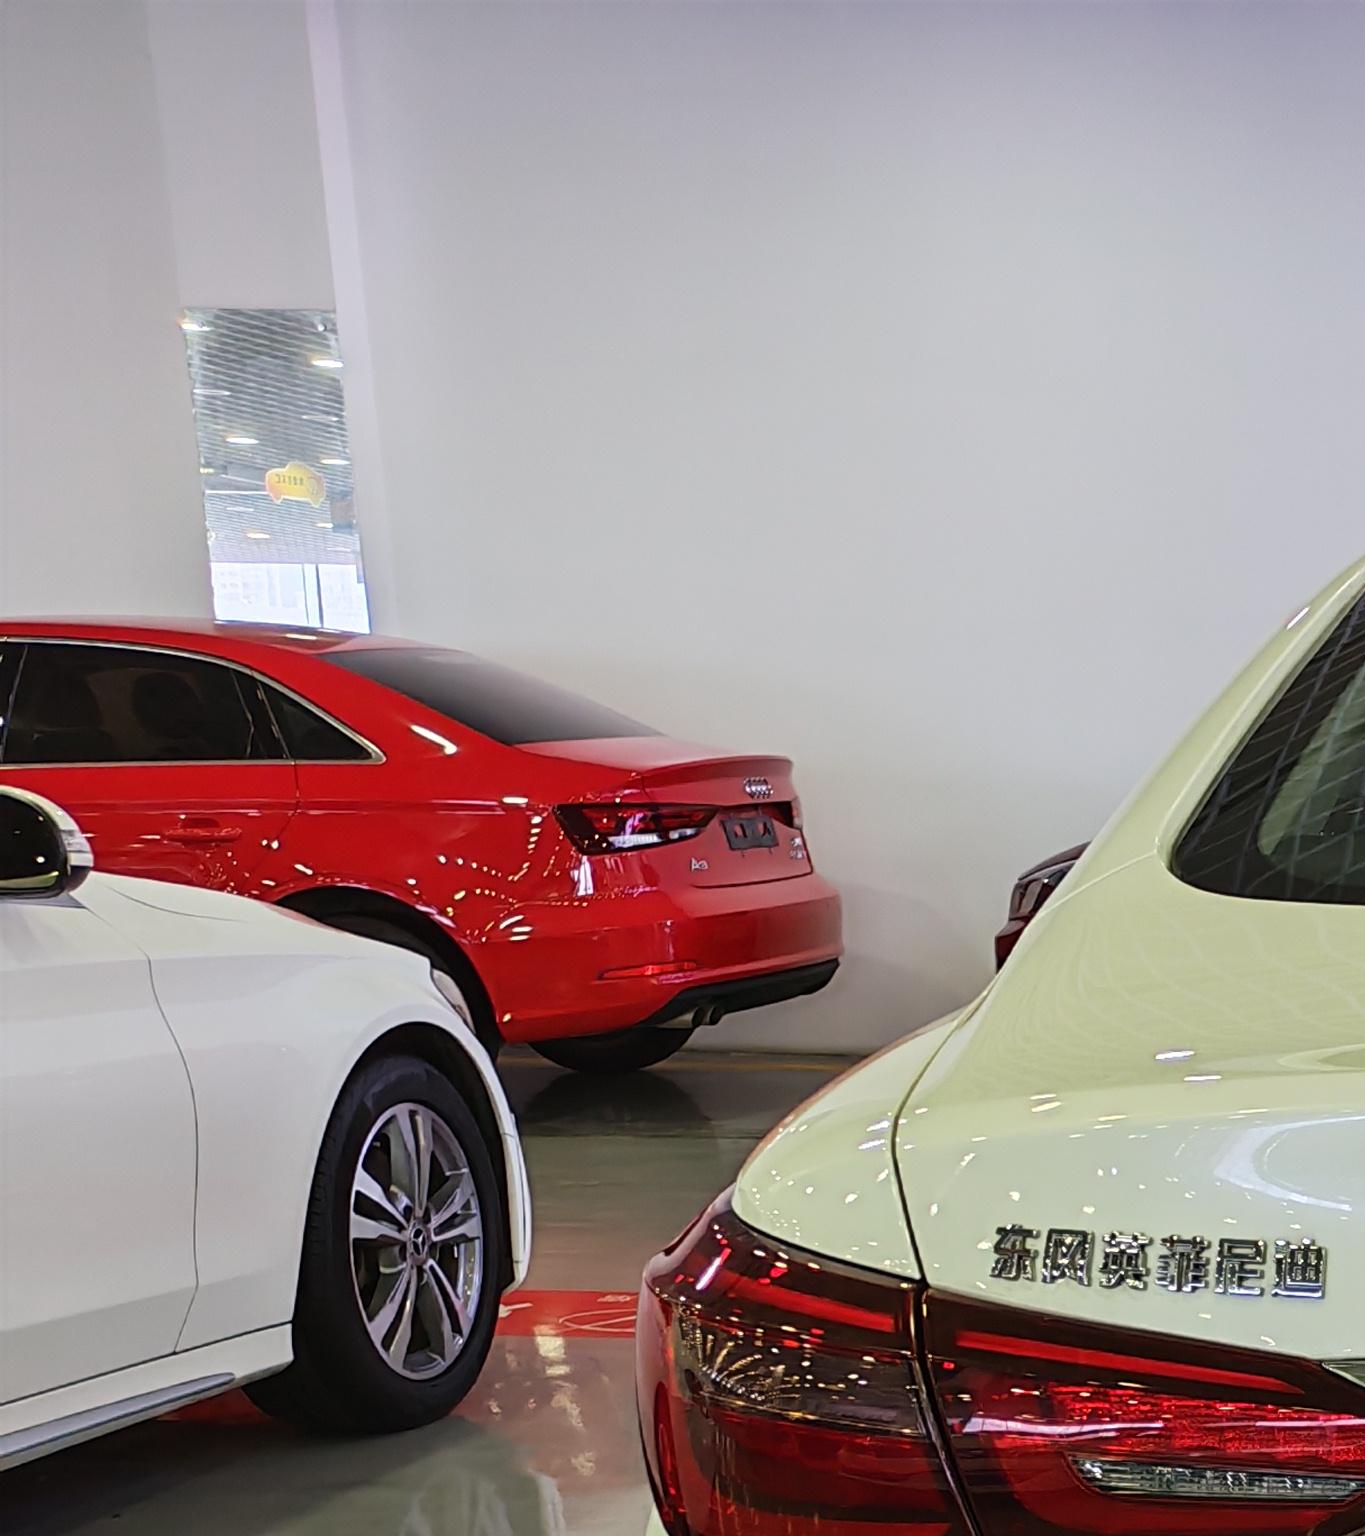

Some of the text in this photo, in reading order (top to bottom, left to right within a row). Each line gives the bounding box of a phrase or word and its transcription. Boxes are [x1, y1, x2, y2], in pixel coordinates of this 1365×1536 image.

[989, 1223, 1328, 1299] 东风英菲尼迪
